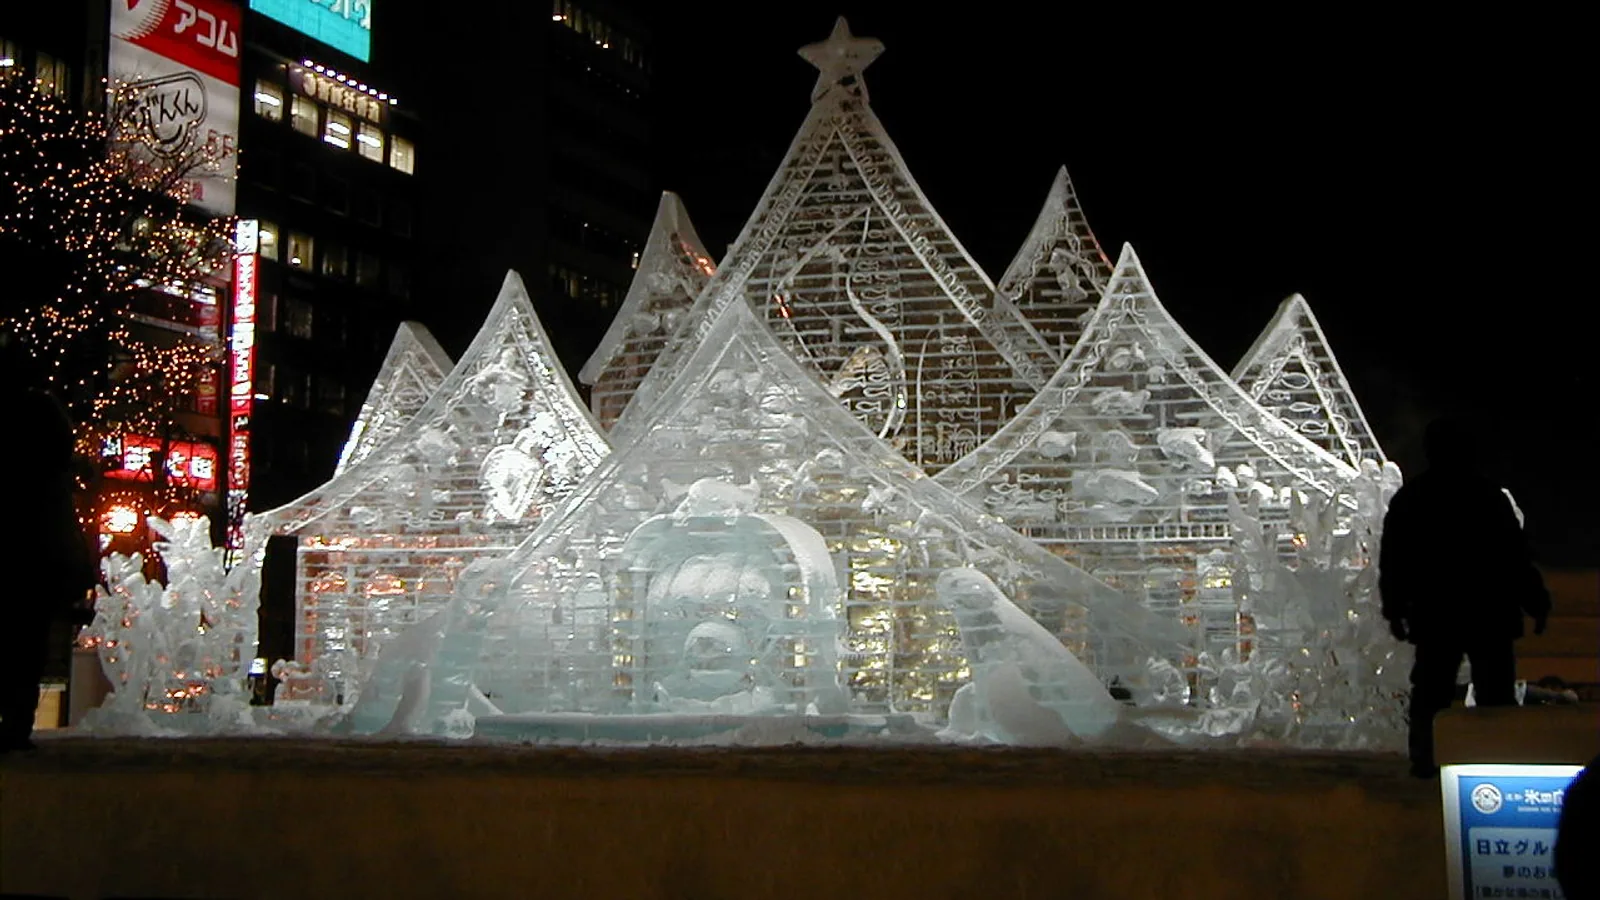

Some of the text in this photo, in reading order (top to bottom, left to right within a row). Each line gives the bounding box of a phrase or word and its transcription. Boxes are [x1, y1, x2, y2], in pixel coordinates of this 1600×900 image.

[174, 0, 238, 58] アコム
[1477, 839, 1549, 855] 日立グル
